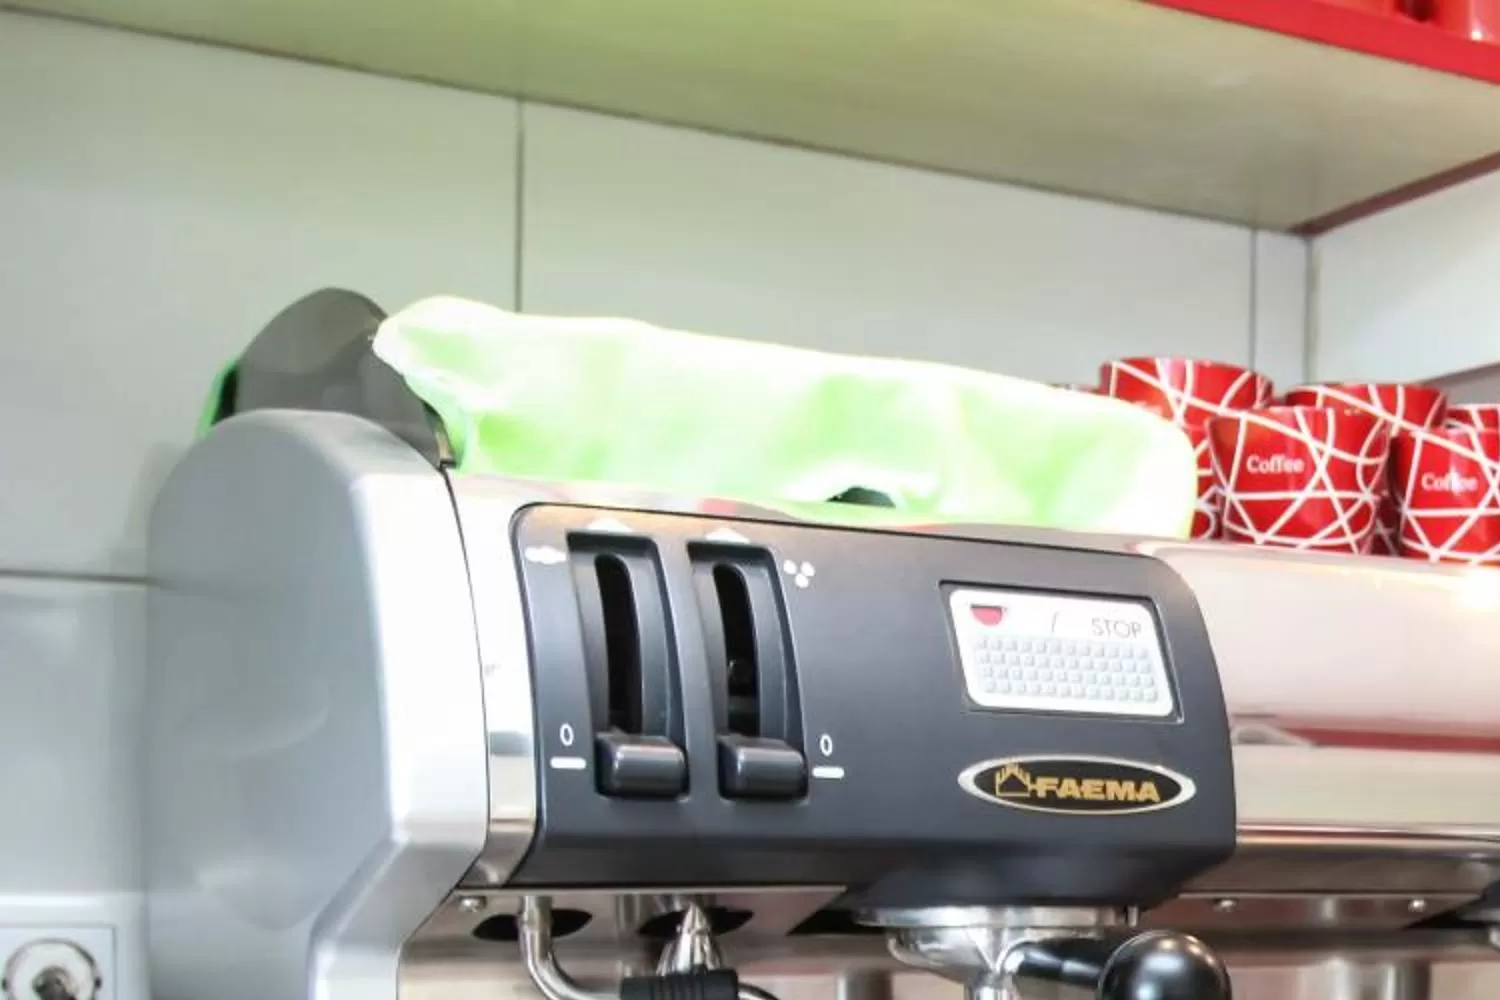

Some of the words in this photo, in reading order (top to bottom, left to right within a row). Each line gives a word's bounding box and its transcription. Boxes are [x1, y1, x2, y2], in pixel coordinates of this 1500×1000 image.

[1247, 456, 1305, 473] Coffee
[1091, 617, 1142, 639] STOP
[1035, 776, 1160, 803] FAEMA
